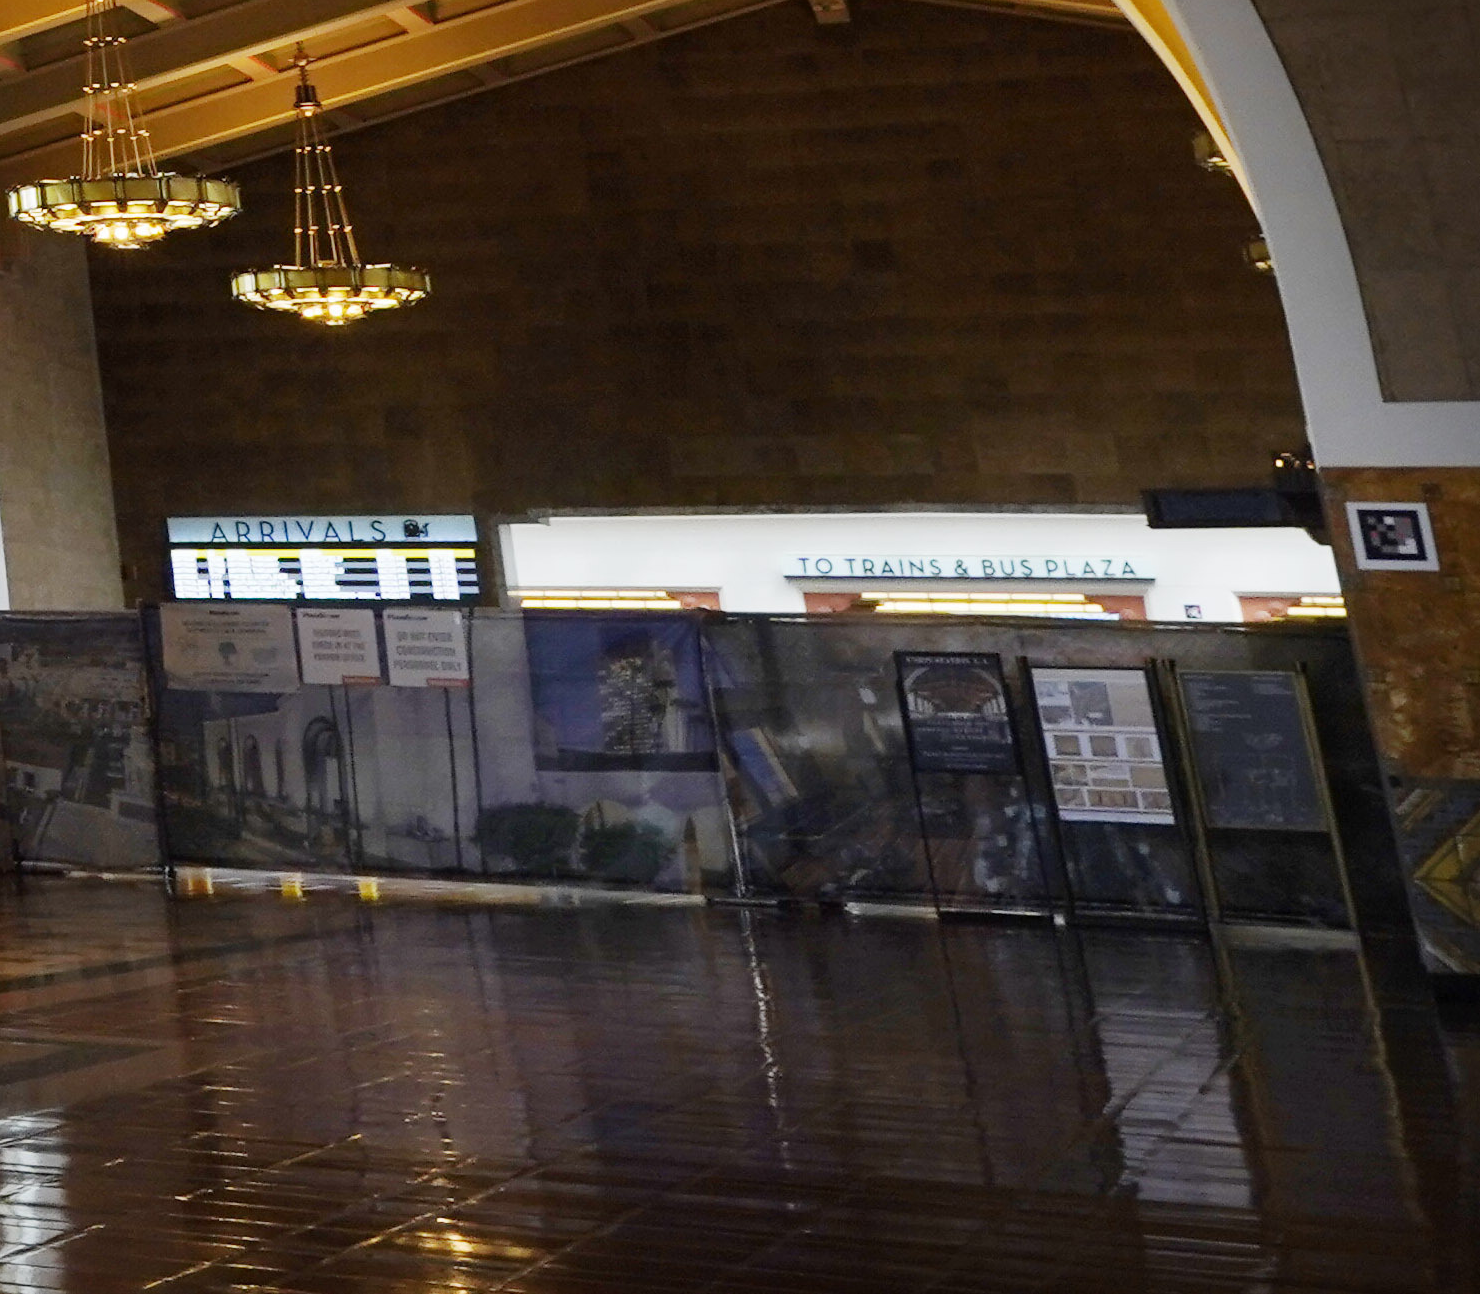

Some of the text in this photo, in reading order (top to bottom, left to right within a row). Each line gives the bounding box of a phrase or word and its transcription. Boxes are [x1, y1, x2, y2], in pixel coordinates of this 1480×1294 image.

[211, 520, 387, 543] ARRIVALS
[797, 557, 1137, 578] TO TRAINS & BUS PLAZA
